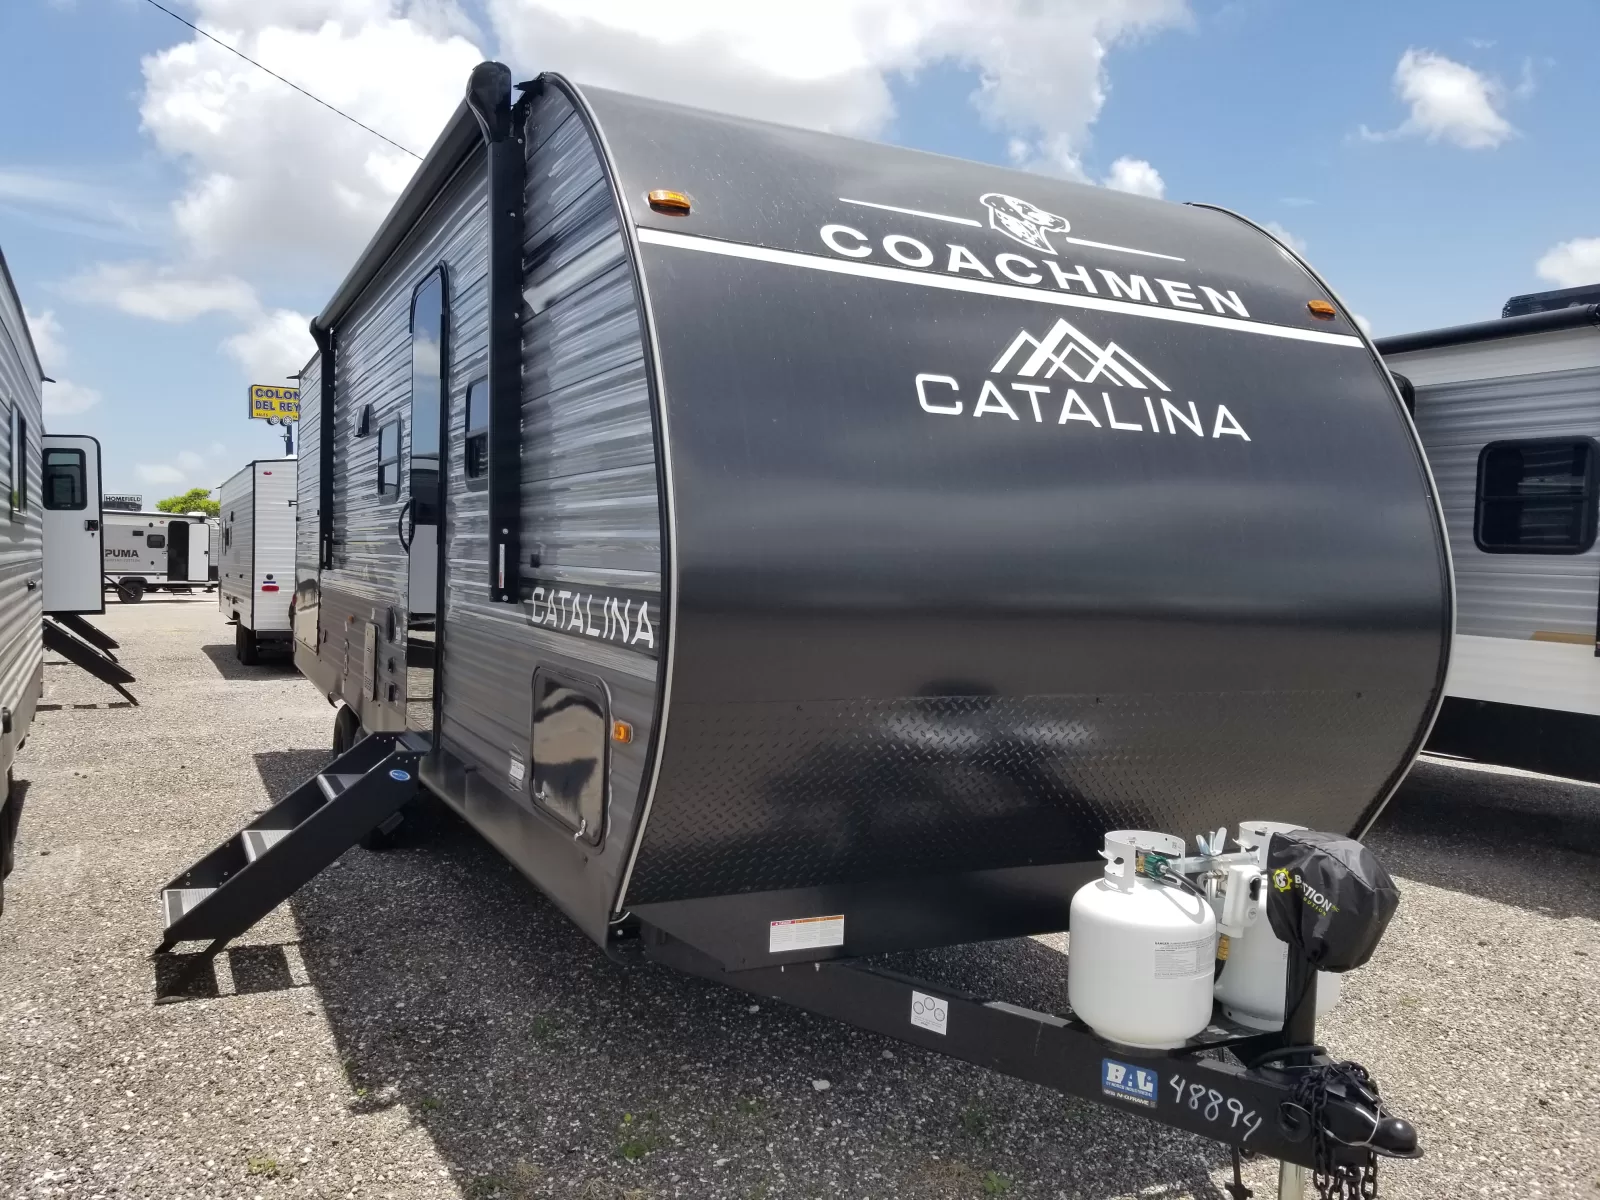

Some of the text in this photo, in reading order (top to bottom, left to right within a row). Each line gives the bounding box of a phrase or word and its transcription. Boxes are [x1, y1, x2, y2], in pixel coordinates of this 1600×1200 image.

[819, 223, 1251, 318] COACHMEN
[255, 400, 300, 412] DEL REY
[914, 372, 1252, 442] CATALINA
[104, 548, 139, 558] PUMA
[531, 587, 654, 649] CATALINA
[1107, 1063, 1153, 1092] BAL
[1169, 1074, 1263, 1142] 48894
